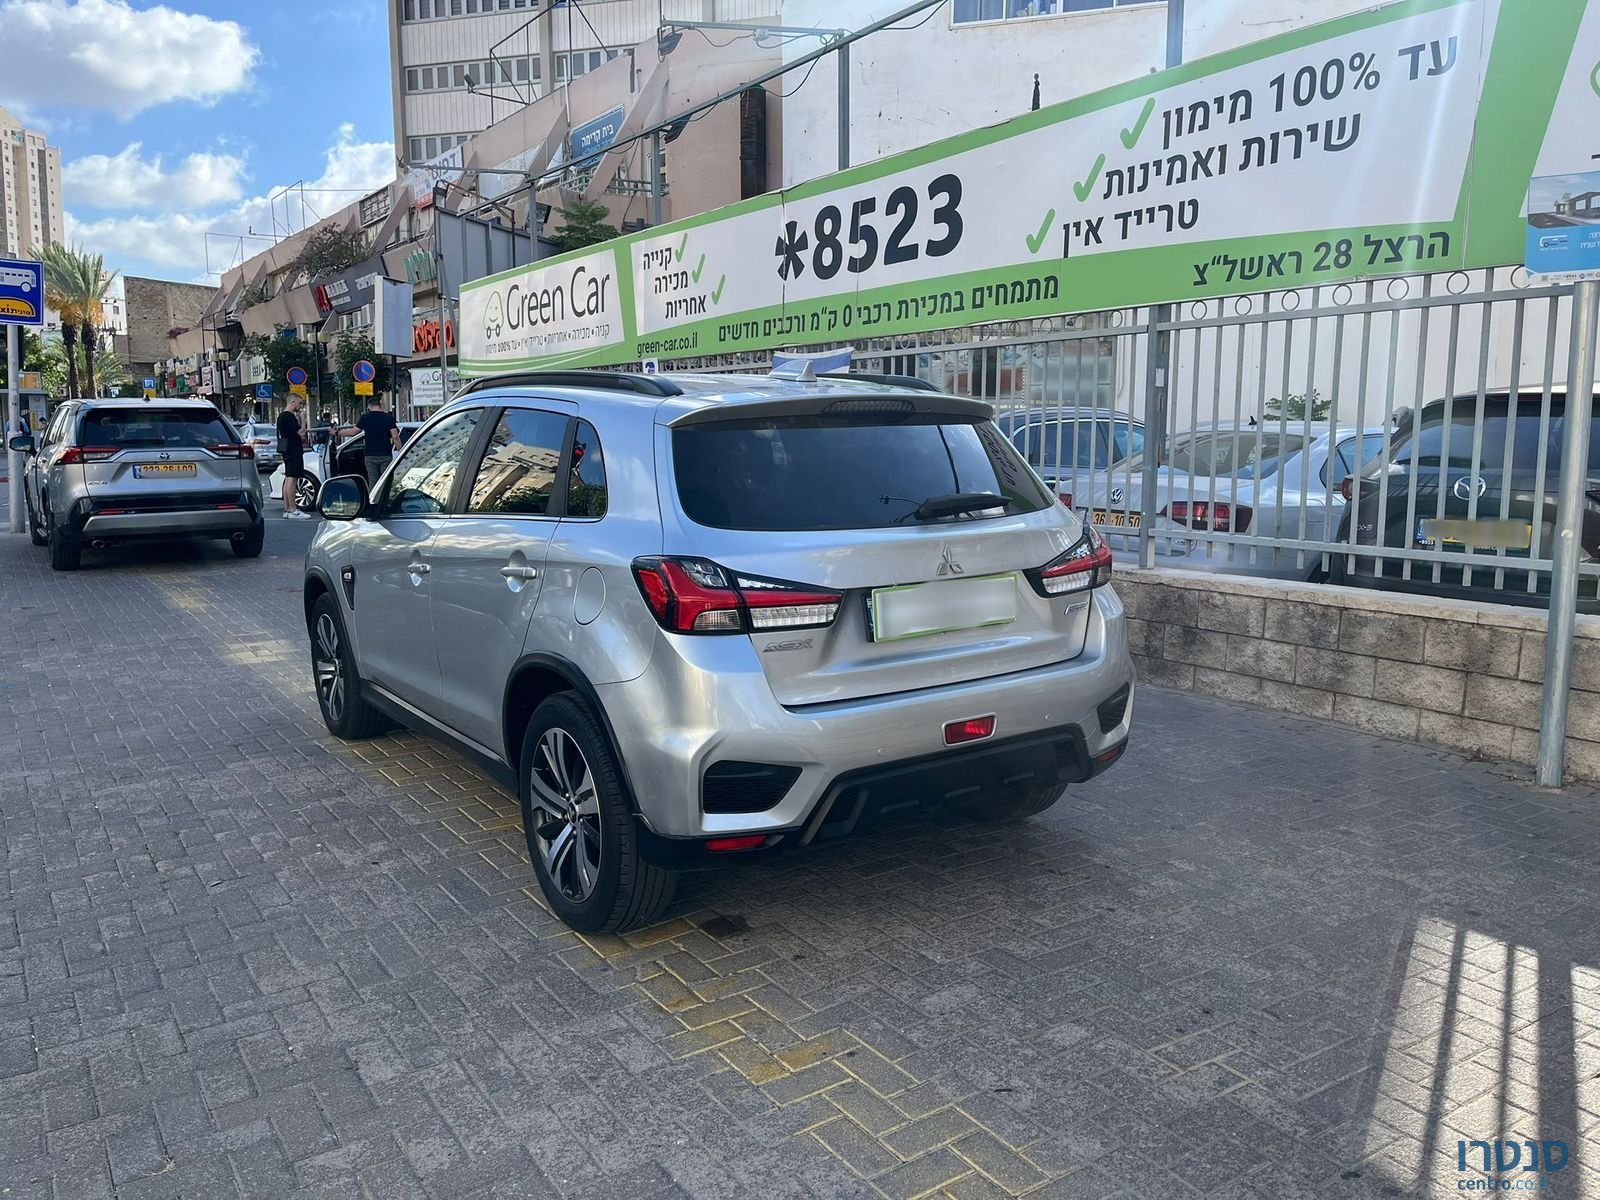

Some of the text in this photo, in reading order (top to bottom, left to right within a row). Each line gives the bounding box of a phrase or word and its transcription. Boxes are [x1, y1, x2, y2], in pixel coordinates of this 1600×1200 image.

[1161, 36, 1458, 151] עד 100% מימון
[602, 124, 614, 138] בית
[1102, 112, 1362, 201] שירות ואמינות
[1062, 198, 1199, 259] טרייד אין
[643, 247, 672, 271] קנייה
[1313, 238, 1353, 273] 28
[1363, 230, 1450, 267] הרצל
[654, 270, 688, 294] מכירה
[971, 275, 1059, 307] מתמחים
[507, 265, 610, 330] Green Car
[665, 294, 707, 319] אחריות
[897, 290, 965, 320] במכירת
[763, 315, 806, 336] ורכבים
[842, 304, 852, 327] 0
[856, 303, 892, 325] רכבי
[547, 331, 568, 345] אחריות
[571, 328, 590, 341] מכירה
[594, 324, 610, 341] קניה
[718, 320, 758, 342] חדשים
[497, 341, 511, 353] 100%
[637, 331, 698, 358] green-car.co.il
[762, 638, 814, 652] ASX
